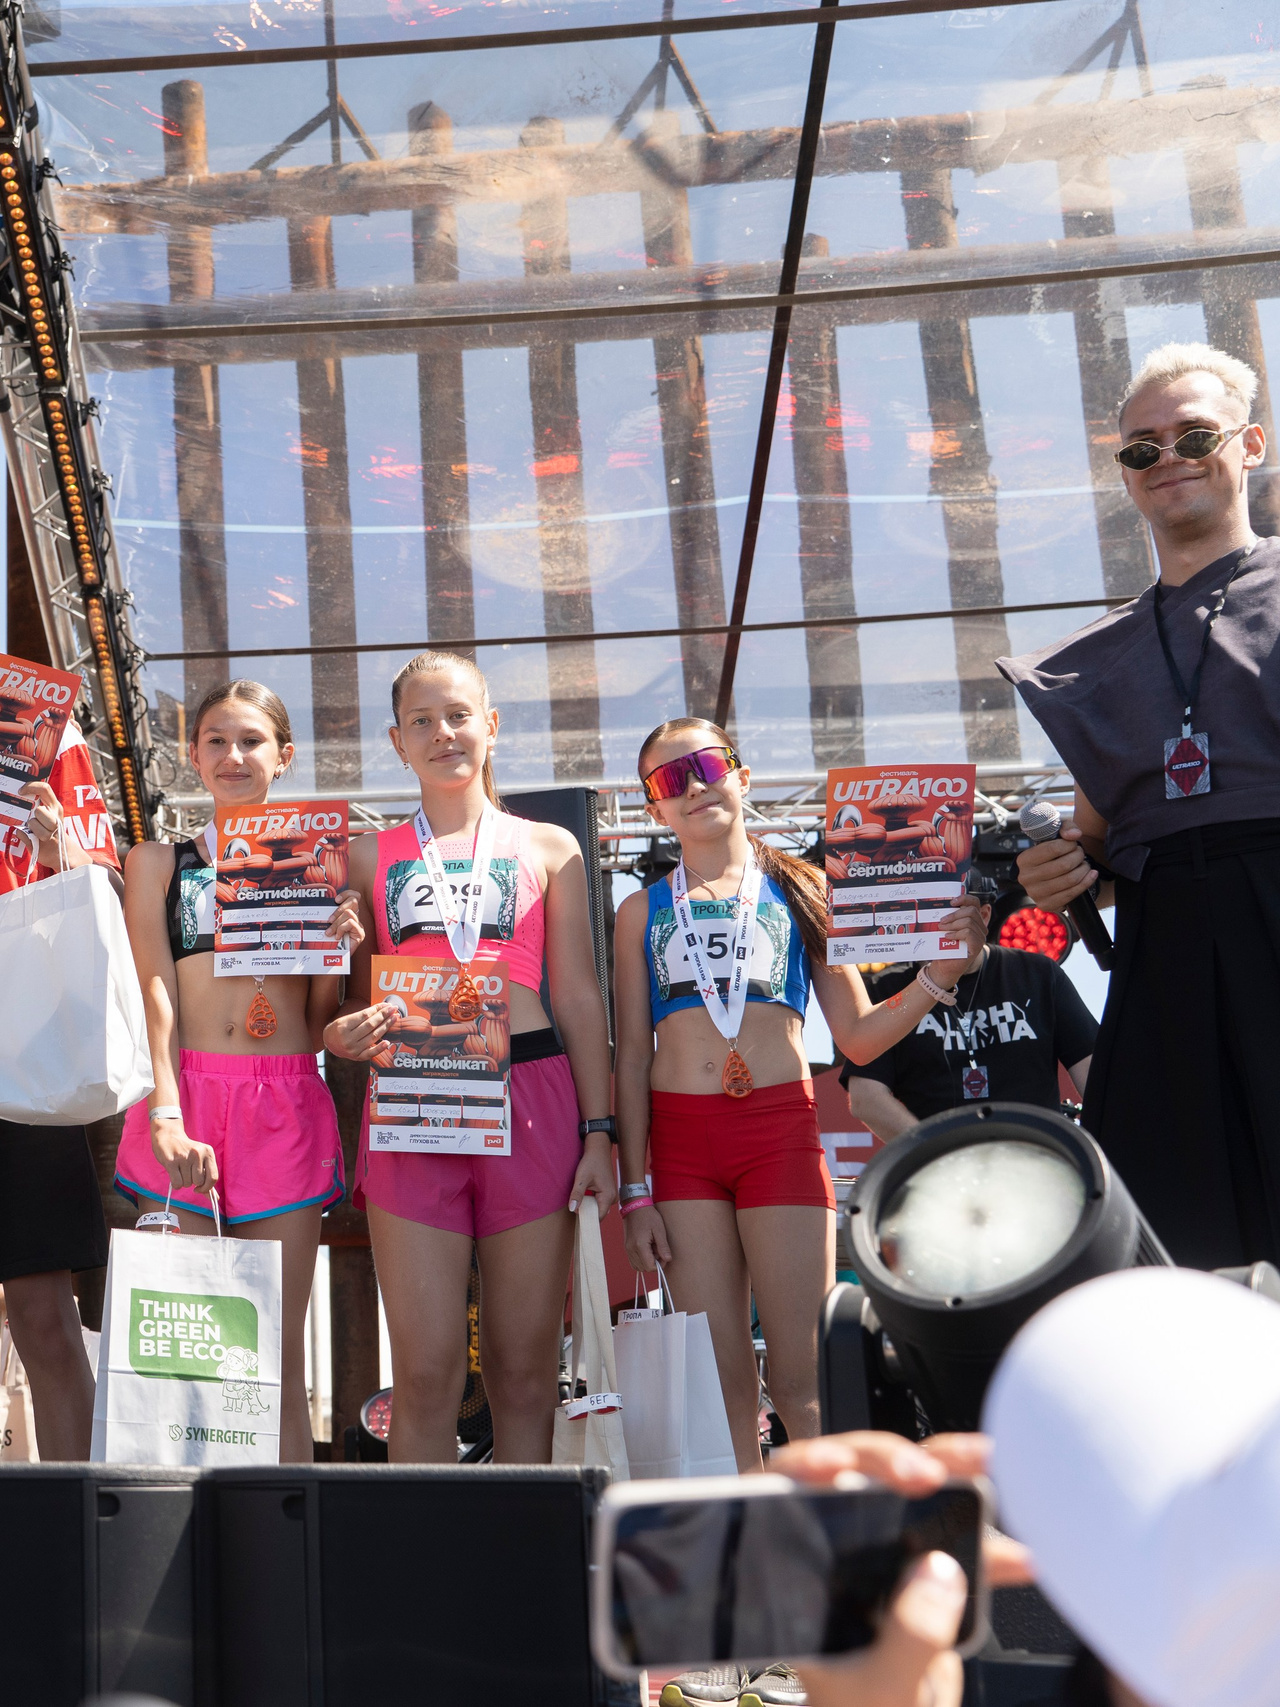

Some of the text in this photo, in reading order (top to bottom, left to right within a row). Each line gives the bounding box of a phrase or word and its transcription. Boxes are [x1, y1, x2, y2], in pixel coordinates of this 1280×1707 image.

[833, 777, 968, 802] ULTRA100
[265, 807, 300, 815] фестиваль
[223, 812, 343, 836] ULTRA100
[847, 860, 946, 878] сертификат
[237, 886, 328, 901] сертификат
[378, 971, 503, 996] ULTRA00
[393, 1055, 489, 1071] сертификат
[138, 1298, 214, 1322] THINK
[138, 1319, 221, 1342] GREEN
[139, 1338, 228, 1362] BE ECO
[589, 1394, 609, 1407] БЕГ
[185, 1427, 257, 1446] SYNERGETIC
